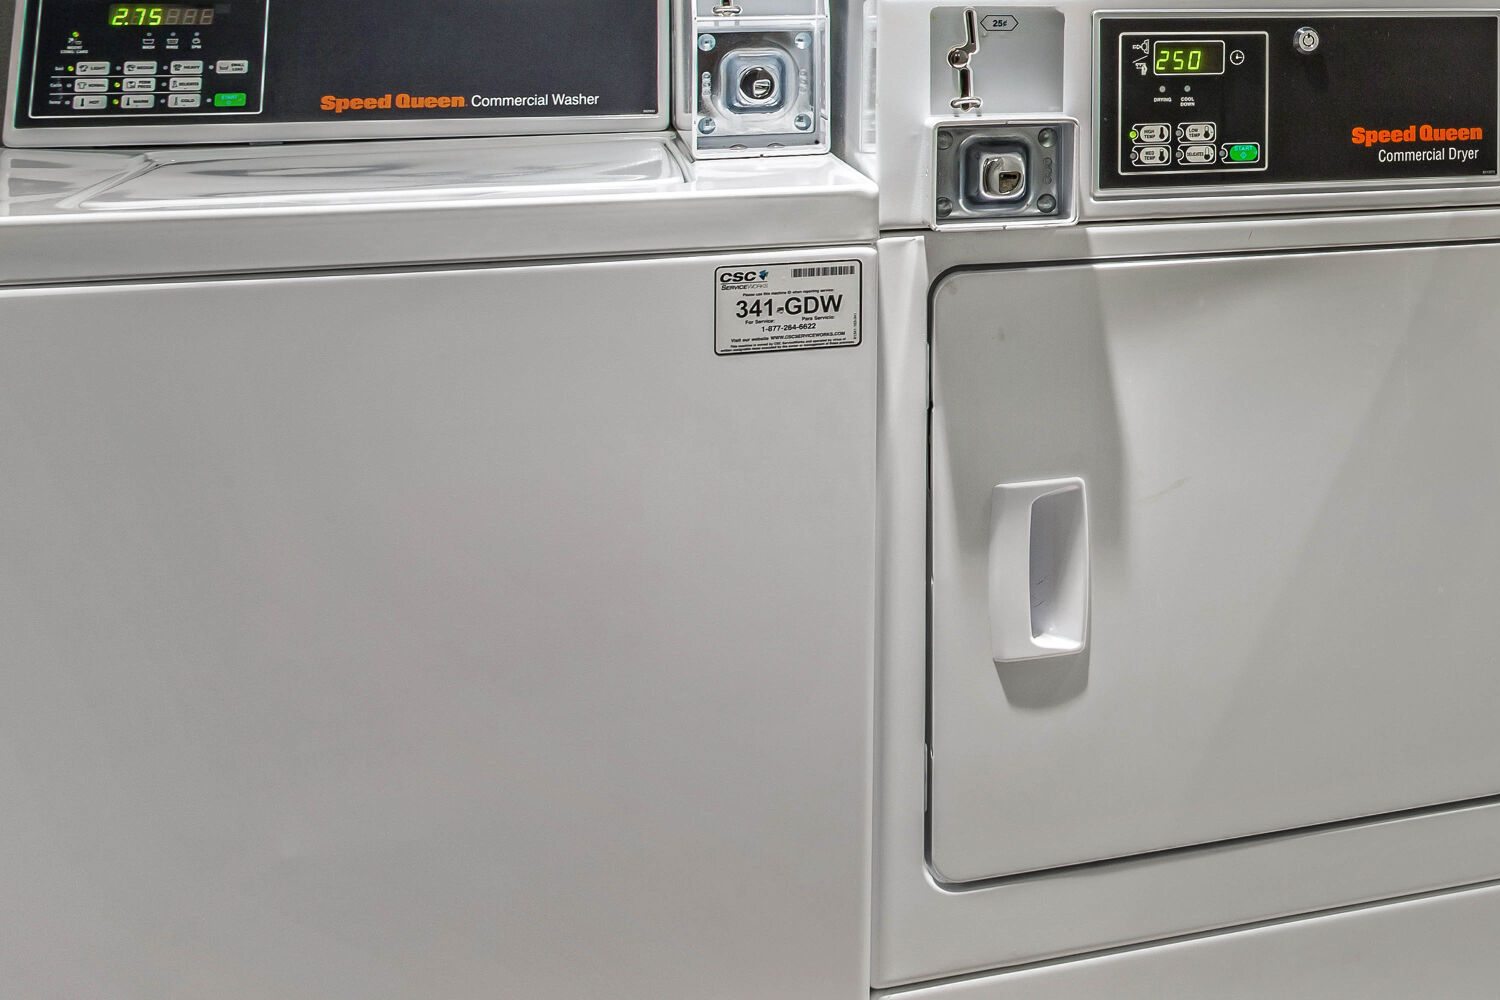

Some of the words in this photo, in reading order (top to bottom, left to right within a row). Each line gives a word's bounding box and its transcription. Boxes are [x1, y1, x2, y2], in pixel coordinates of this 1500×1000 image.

[112, 8, 162, 25] 2.75
[320, 94, 391, 114] Speed
[395, 94, 465, 109] Queen
[471, 94, 548, 107] Commercial
[552, 94, 599, 106] Washer
[1352, 125, 1416, 147] Speed
[1419, 124, 1482, 141] Queen
[1378, 148, 1444, 162] Commercial
[1448, 148, 1479, 162] Dryer
[720, 272, 756, 282] CSC
[736, 295, 843, 318] 341-GDW
[761, 323, 816, 332] 1-877-264-6622
